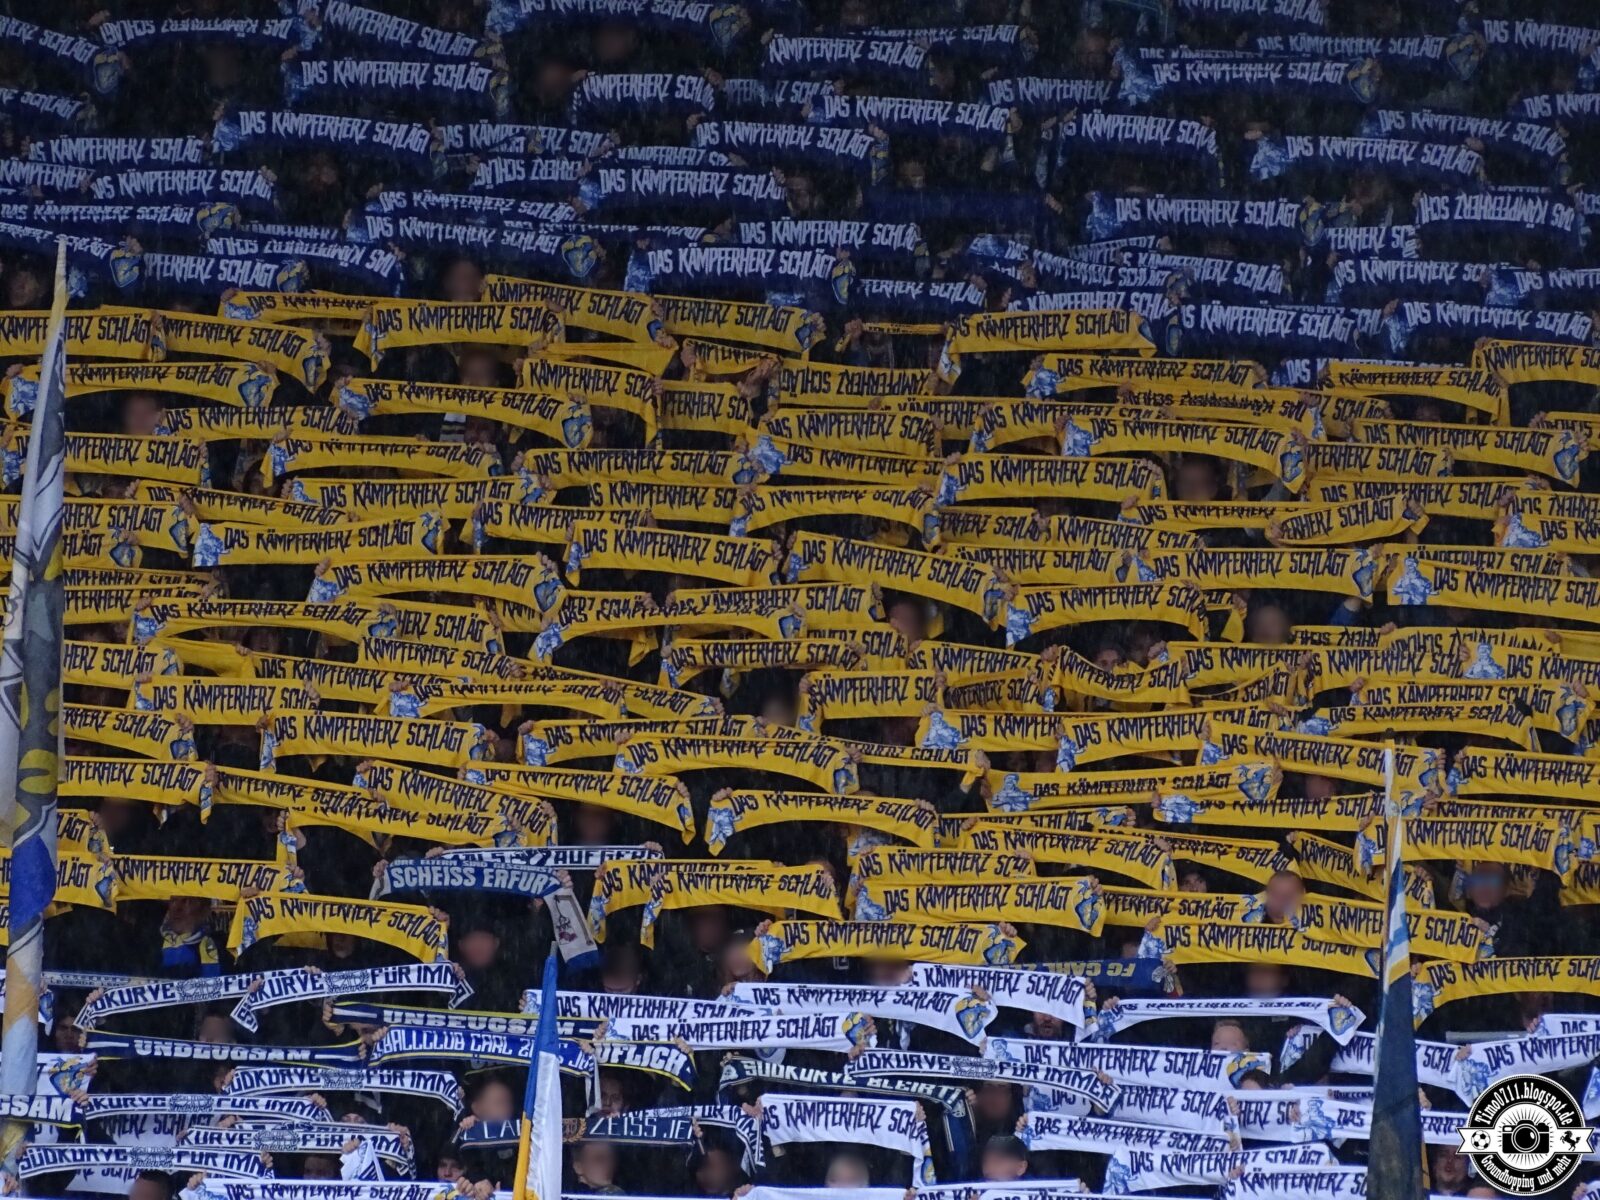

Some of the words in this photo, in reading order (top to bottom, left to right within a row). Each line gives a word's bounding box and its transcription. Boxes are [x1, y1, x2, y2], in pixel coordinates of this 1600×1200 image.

[418, 27, 478, 57] SCHLÄGT
[769, 34, 862, 65] KÄMPFERHERZ
[301, 62, 327, 86] DAS
[333, 57, 429, 89] KÄMPFERHERZ
[433, 62, 492, 92] SCHLÄGT
[240, 112, 266, 135] DAS
[272, 110, 371, 140] KÄMPFERHERZ
[373, 123, 431, 154] SCHLÄGT
[1081, 108, 1175, 143] KÄMPFERHERZ
[50, 135, 145, 164] KÄMPFERHERZ
[818, 127, 874, 158] SCHLÄGT
[1286, 136, 1313, 157] DAS
[119, 169, 216, 196] KÄMPFERHERZ
[599, 169, 625, 195] DAS
[632, 166, 727, 199] KÄMPFERHERZ
[1115, 199, 1140, 222] DAS
[1146, 194, 1239, 227] KÄMPFERHERZ
[1244, 198, 1300, 229] SCHLÄGT
[366, 216, 392, 240] DAS
[739, 223, 766, 244] DAS
[771, 217, 869, 250] KÄMPFERHERZ
[218, 252, 278, 289] SCHLÄGT
[649, 250, 672, 275] DAS
[678, 244, 775, 277] KÄMPFERHERZ
[779, 249, 836, 280] SCHLÄGT
[1361, 257, 1455, 285] KÄMPFERHERZ
[377, 310, 402, 333] DAS
[408, 303, 504, 334] KÄMPFERHERZ
[588, 290, 648, 324] SCHLÄGT
[1404, 302, 1430, 326] DAS
[1437, 301, 1531, 330] KÄMPFERHERZ
[1536, 311, 1591, 341] SCHLÄGT
[976, 312, 1070, 342] KÄMPFERHERZ
[1201, 301, 1292, 338] KÄMPFERHERZ
[1299, 308, 1355, 344] SCHLÄGT
[249, 328, 307, 359] SCHLÄGT
[70, 364, 168, 383] KÄMPFERHERZ
[530, 359, 621, 393] KÄMPFERHERZ
[1057, 358, 1083, 377] DAS
[1089, 356, 1187, 381] KÄMPFERHERZ
[1190, 361, 1253, 386] SCHLÄGT
[1339, 368, 1443, 386] KÄMPFERHERZ
[364, 384, 392, 401] DAS
[767, 419, 791, 439] DAS
[798, 411, 896, 441] KÄMPFERHERZ
[147, 439, 201, 470] SCHLÄGT
[536, 454, 561, 474] DAS
[568, 449, 664, 475] KÄMPFERHERZ
[672, 452, 732, 476] SCHLÄGT
[1377, 448, 1437, 475] SCHLÄGT
[959, 462, 984, 484] DAS
[991, 456, 1087, 486] KÄMPFERHERZ
[1094, 461, 1152, 488] SCHLÄGT
[320, 485, 346, 508] DAS
[108, 502, 166, 533] SCHLÄGT
[224, 527, 250, 549] DAS
[256, 529, 351, 555] KÄMPFERHERZ
[359, 521, 415, 547] SCHLÄGT
[583, 529, 607, 553] DAS
[615, 530, 711, 561] KÄMPFERHERZ
[714, 542, 772, 573] SCHLÄGT
[333, 564, 362, 587] DAS
[472, 559, 534, 588] SCHLÄGT
[803, 540, 826, 564] DAS
[928, 561, 986, 595] SCHLÄGT
[1054, 550, 1115, 574] SCHLÄGT
[1154, 556, 1180, 577] DAS
[1290, 551, 1350, 577] SCHLÄGT
[806, 585, 866, 614] SCHLÄGT
[1434, 569, 1459, 590] DAS
[1465, 571, 1560, 603] KÄMPFERHERZ
[151, 604, 181, 623] DAS
[188, 600, 297, 617] KÄMPFERHERZ
[302, 603, 371, 625] SCHLÄGT
[435, 613, 490, 643] SCHLÄGT
[101, 646, 158, 675] SCHLÄGT
[153, 686, 177, 710] DAS
[184, 680, 276, 711] KÄMPFERHERZ
[113, 711, 174, 744] SCHLÄGT
[276, 717, 296, 740] DAS
[304, 711, 402, 748] KÄMPFERHERZ
[407, 722, 468, 752] SCHLÄGT
[630, 741, 658, 763] DAS
[773, 740, 839, 769] SCHLÄGT
[1222, 734, 1247, 756] DAS
[1255, 732, 1352, 766] KÄMPFERHERZ
[141, 762, 201, 791] SCHLÄGT
[1033, 783, 1059, 797] DAS
[1172, 772, 1232, 790] SCHLÄGT
[1462, 756, 1487, 779] DAS
[1494, 754, 1593, 785] KÄMPFERHERZ
[368, 766, 392, 790] DAS
[399, 766, 497, 812] KÄMPFERHERZ
[498, 795, 550, 835] SCHLÄGT
[617, 773, 679, 807] SCHLÄGT
[732, 794, 759, 815] DAS
[427, 812, 493, 836] SCHLÄGT
[1501, 821, 1554, 853] SCHLÄGT
[859, 855, 882, 877] DAS
[890, 851, 993, 876] KÄMPFERHERZ
[971, 832, 997, 851] DAS
[1105, 839, 1163, 868] SCHLÄGT
[218, 863, 280, 893] SCHLÄGT
[391, 867, 476, 887] SCHEISS
[884, 890, 909, 914] DAS
[915, 884, 1008, 913] KÄMPFERHERZ
[1016, 881, 1072, 911] SCHLÄGT
[1179, 897, 1238, 920] SCHLÄGT
[784, 923, 808, 944] DAS
[919, 926, 983, 952] SCHLÄGT
[1165, 925, 1190, 949] DAS
[1425, 920, 1480, 948] SCHLÄGT
[371, 968, 407, 985] FÜR
[1026, 973, 1086, 1007] SCHLÄGT
[556, 995, 581, 1017] DAS
[632, 1023, 659, 1041] DAS
[667, 1020, 771, 1042] KÄMPFERHERZ
[777, 1014, 839, 1038] SCHLÄGT
[1058, 1043, 1156, 1076] KÄMPFERHERZ
[1164, 1051, 1227, 1079] SCHLÄGT
[1487, 1048, 1514, 1071] DAS
[1000, 1062, 1038, 1078] FÜR
[1046, 1070, 1119, 1102] IMMER
[590, 1116, 656, 1137] ZEISS
[1035, 1116, 1061, 1135] DAS
[1338, 1109, 1364, 1128] DAS
[1131, 1150, 1154, 1175] DAS
